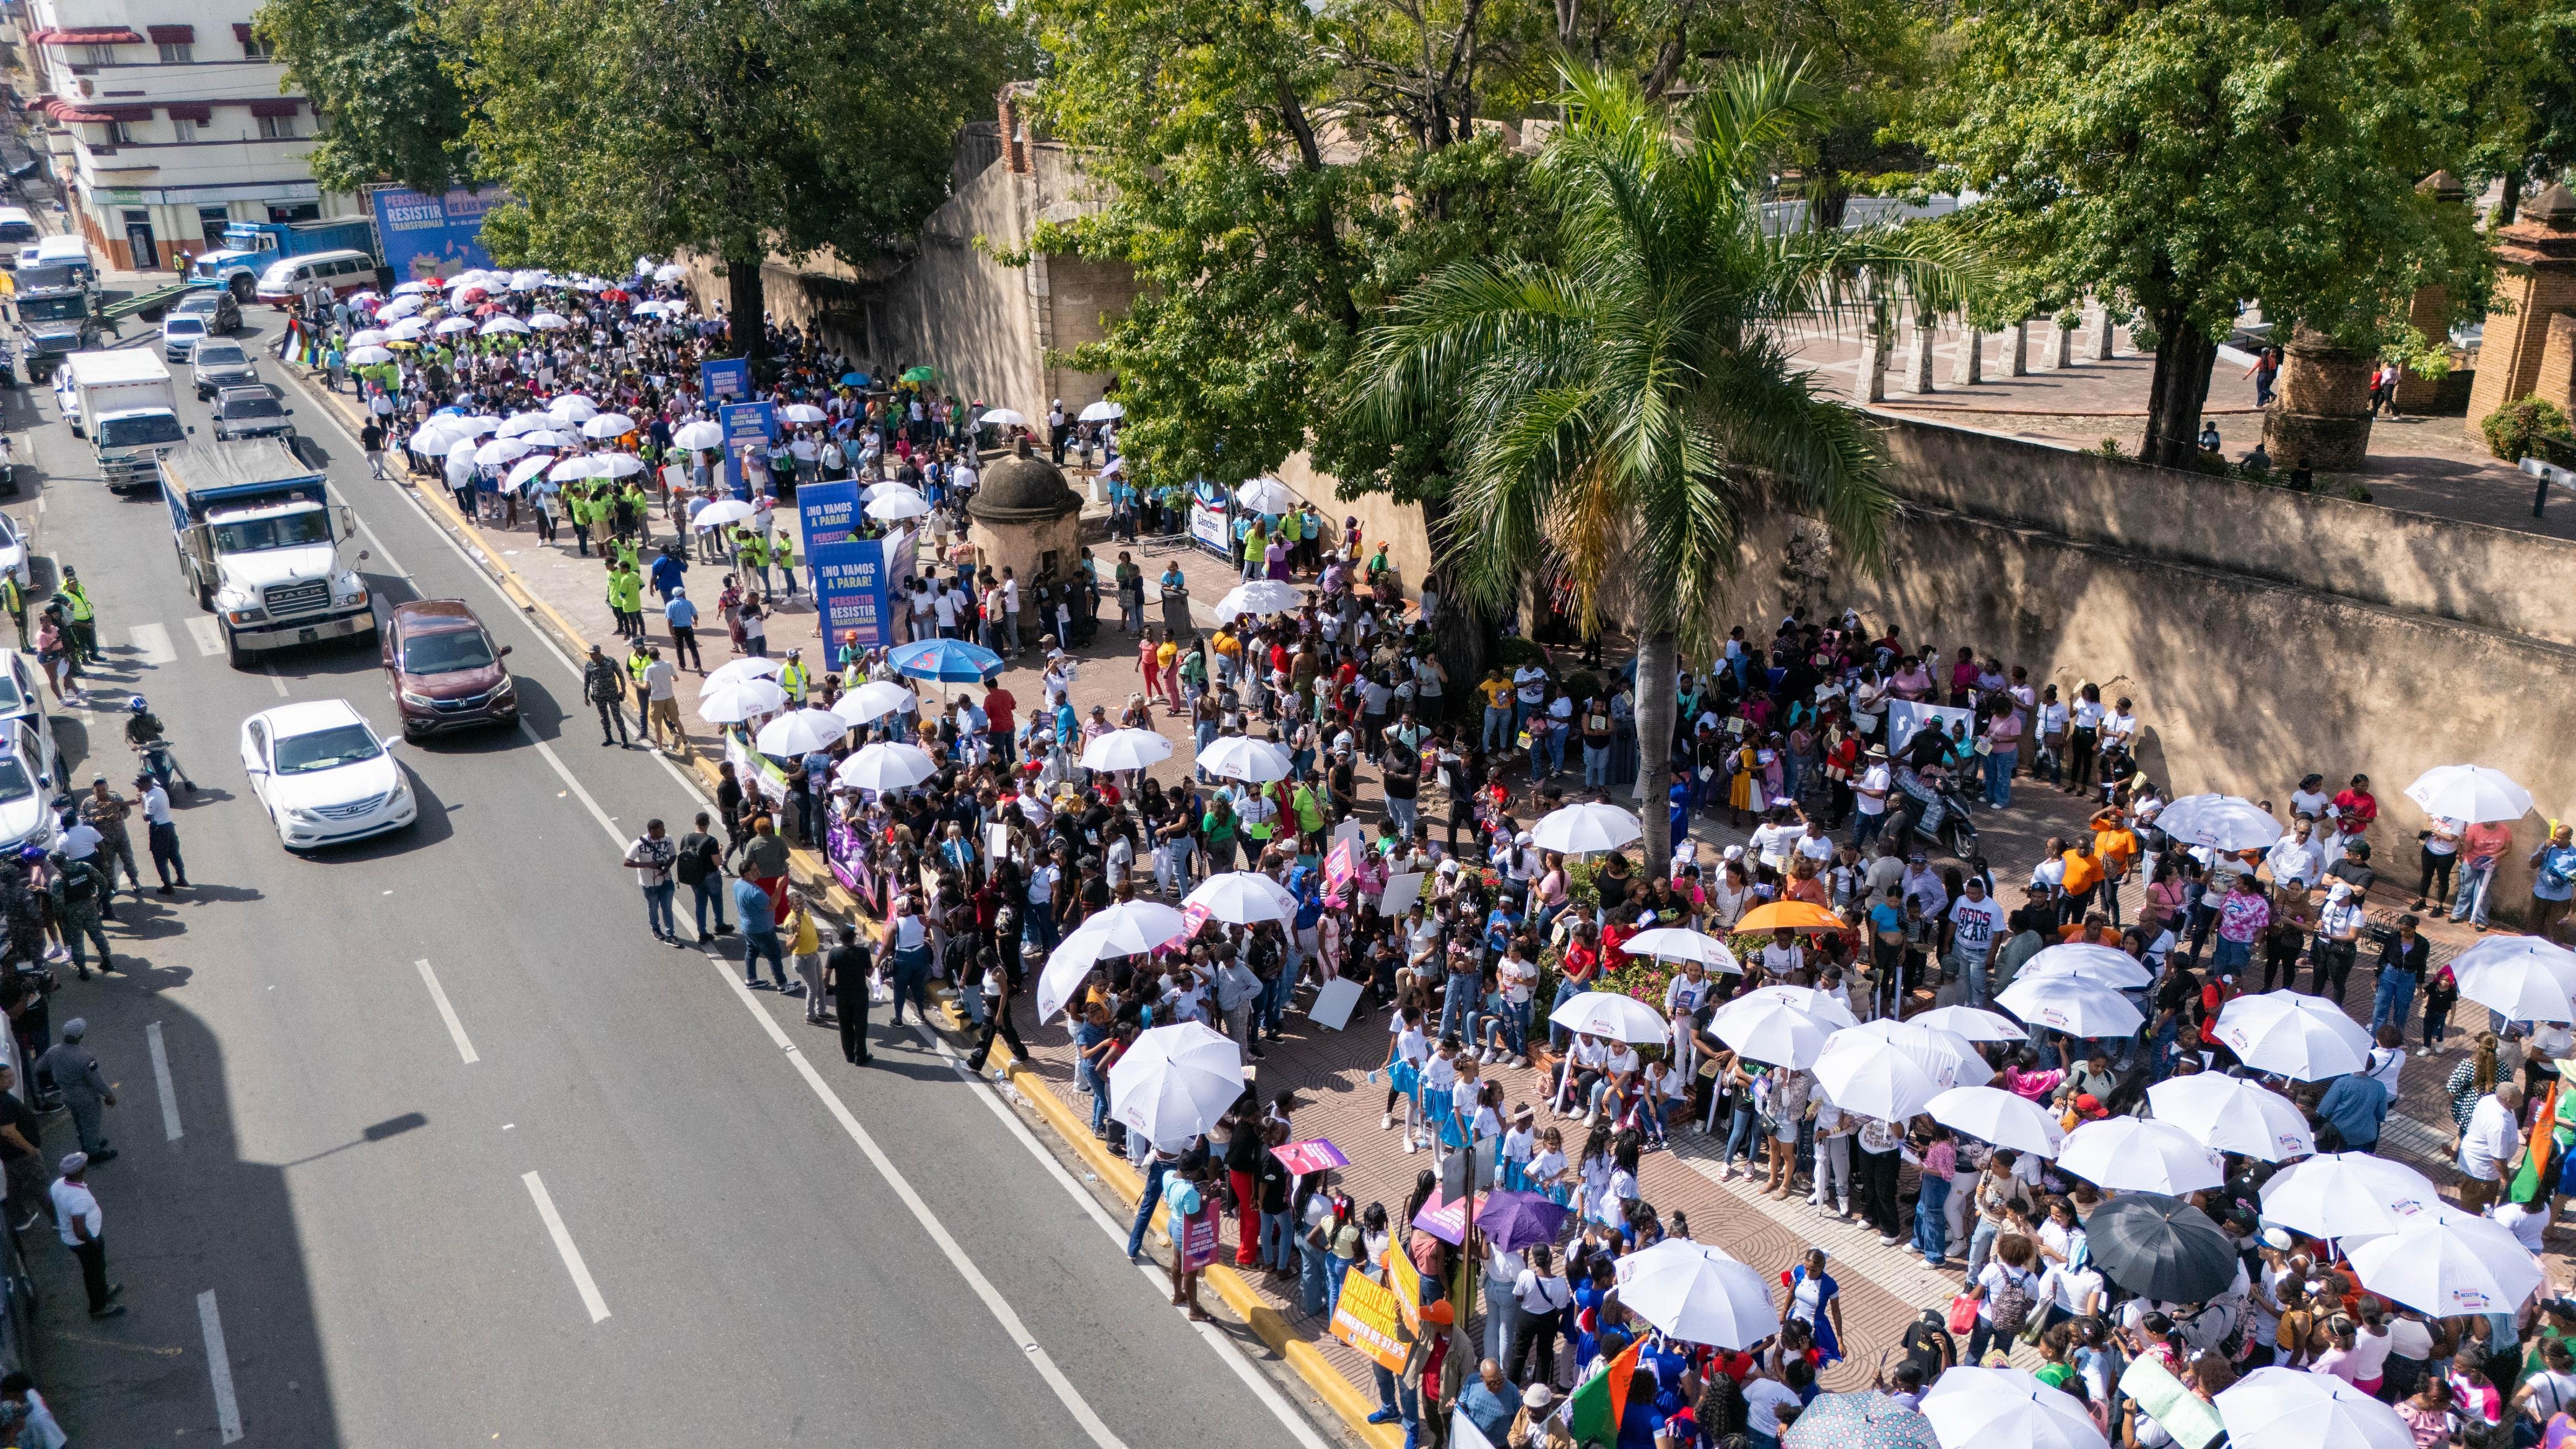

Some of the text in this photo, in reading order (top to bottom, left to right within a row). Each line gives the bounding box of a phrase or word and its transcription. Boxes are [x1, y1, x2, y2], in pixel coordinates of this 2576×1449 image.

[108, 192, 140, 201] Presidente
[387, 205, 443, 222] RESISTIR
[449, 203, 460, 213] DE
[463, 202, 477, 212] LAS
[390, 219, 445, 232] TRANSFORMAR
[711, 372, 737, 380] NUESTROS
[712, 378, 738, 386] DERECHOS
[807, 502, 852, 516] ¡NO VAMOS
[812, 513, 850, 527] A PARAR!
[1198, 514, 1218, 532] Sánchez
[822, 563, 875, 577] ¡NO VAMOS
[828, 576, 872, 590] A PARAR!
[269, 588, 323, 601] MACK
[829, 594, 874, 607] PERSISTIR
[830, 605, 876, 619] RESISTIR
[832, 617, 877, 626] TRANSFORMAR
[767, 781, 783, 795] NUESTRO
[1959, 907, 1991, 926] GODS
[1186, 1247, 1199, 1256] JUSTICIA
[1345, 1269, 1382, 1310] REAJUSTE
[1340, 1292, 1353, 1314] POR
[1336, 1308, 1370, 1338] AUMENTO
[1370, 1326, 1381, 1344] DE
[1380, 1335, 1406, 1358] 37.5%
[1355, 1336, 1384, 1359] UCT
